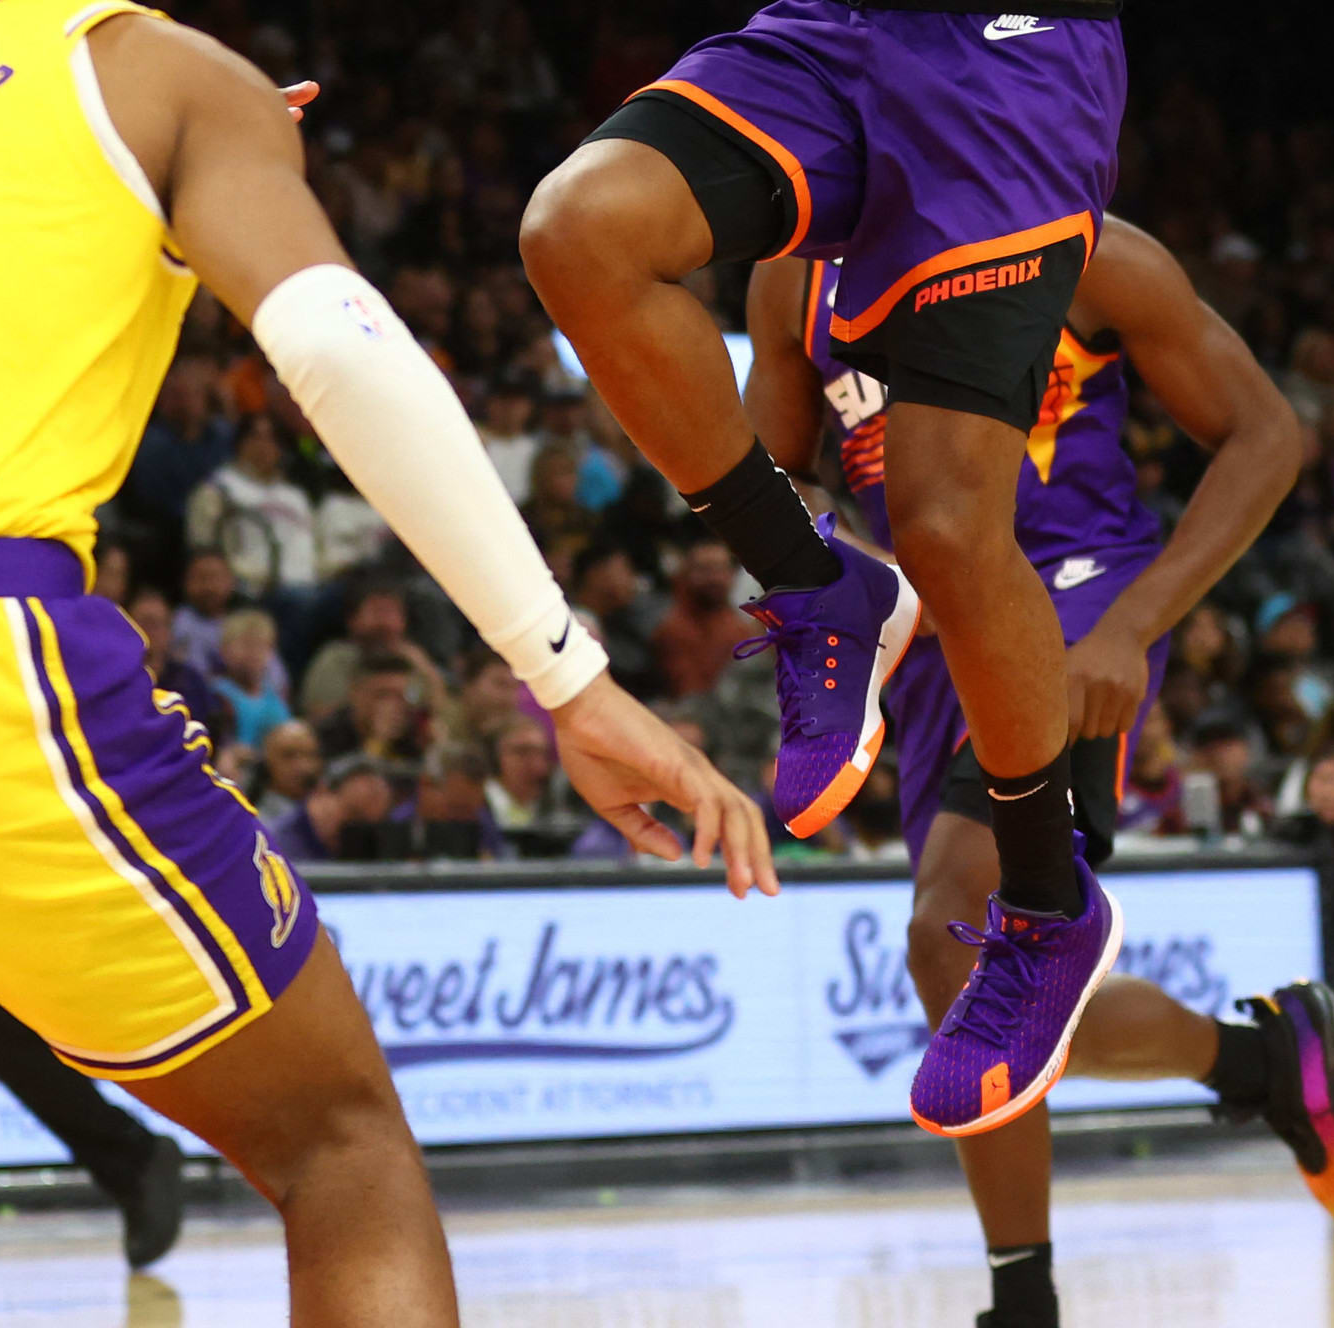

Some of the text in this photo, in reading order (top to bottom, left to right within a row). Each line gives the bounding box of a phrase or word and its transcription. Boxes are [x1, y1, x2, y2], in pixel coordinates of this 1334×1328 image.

[914, 255, 1043, 313] PHOENIX
[325, 922, 498, 1030] weet
[496, 922, 720, 1030] James
